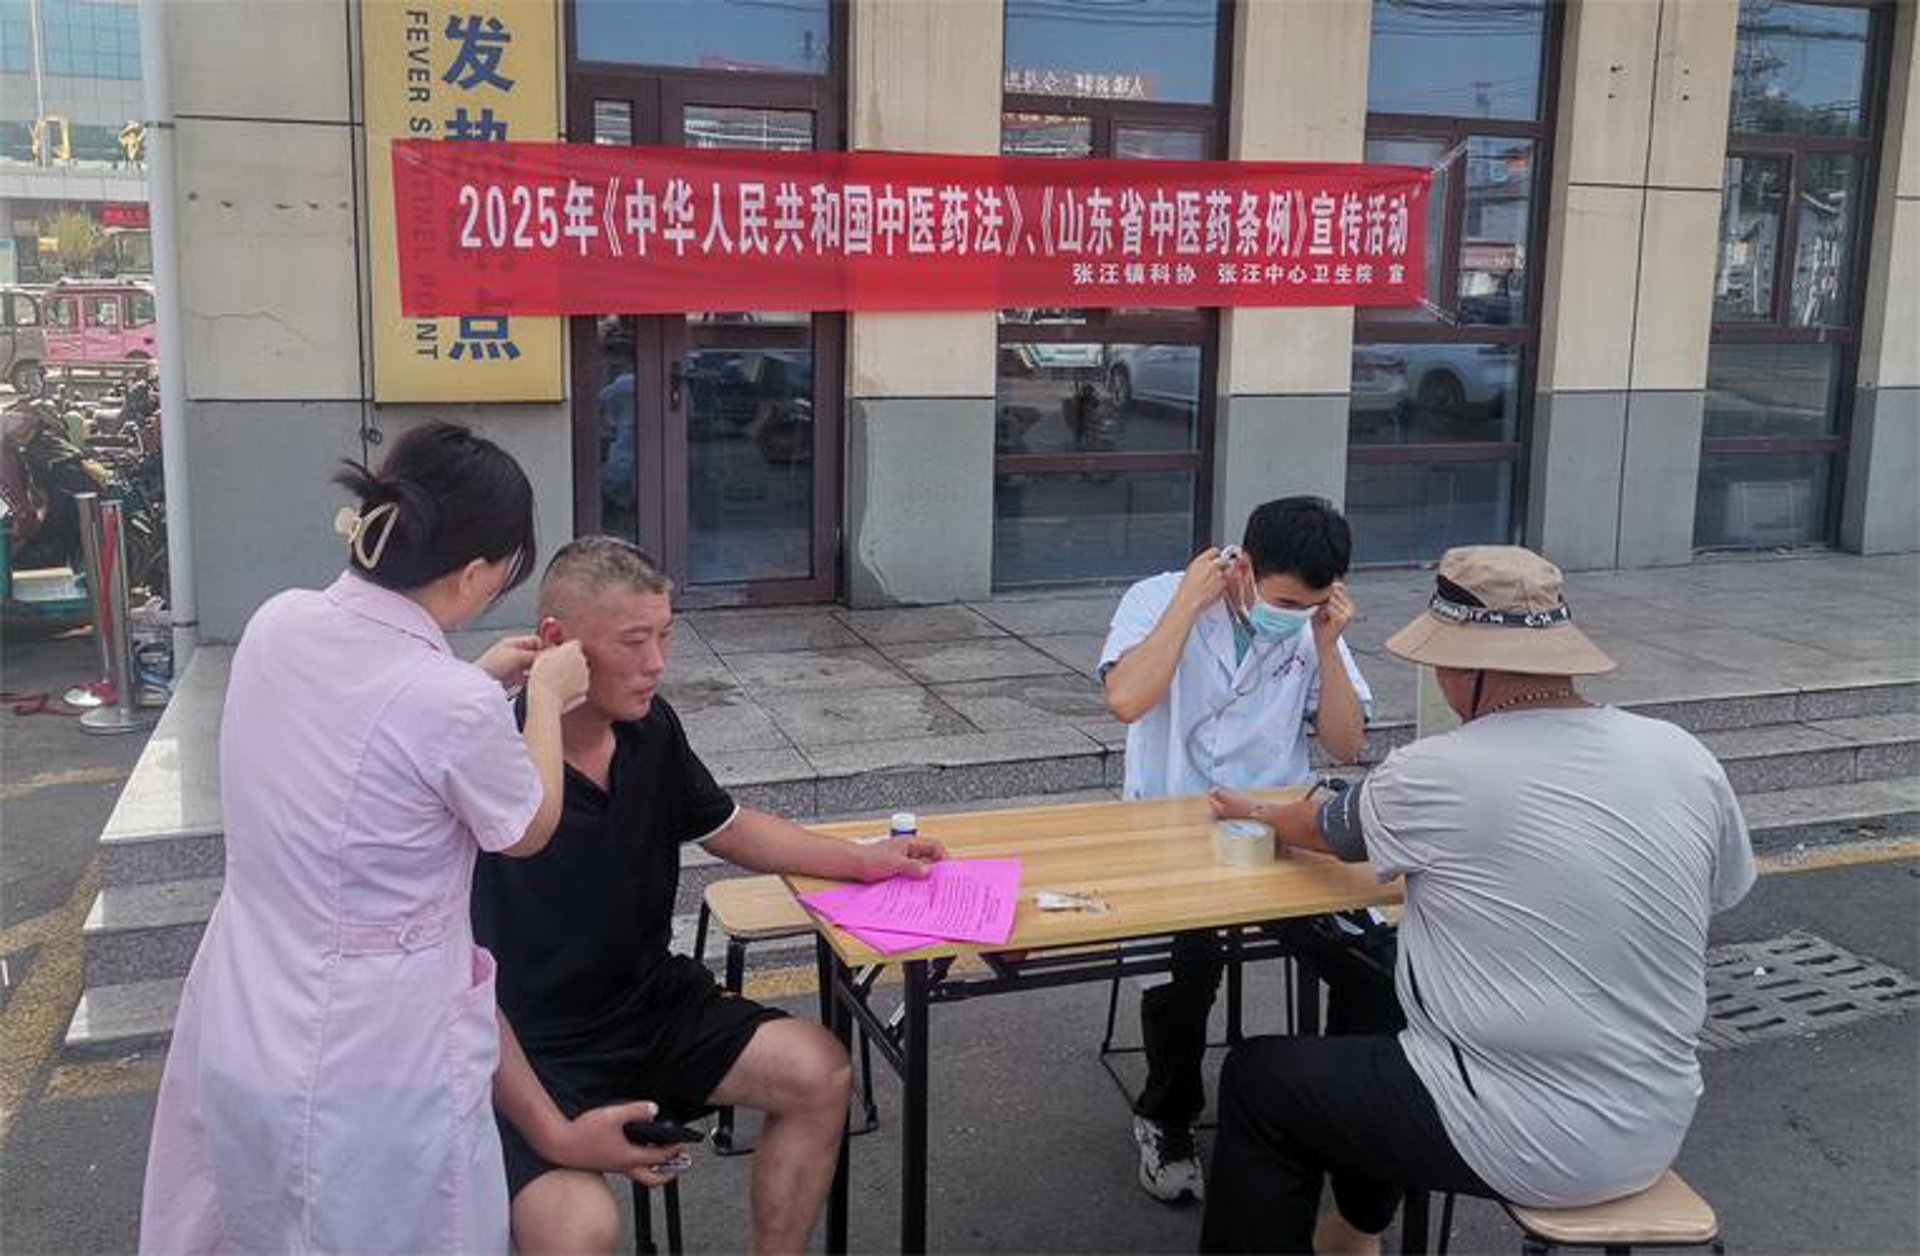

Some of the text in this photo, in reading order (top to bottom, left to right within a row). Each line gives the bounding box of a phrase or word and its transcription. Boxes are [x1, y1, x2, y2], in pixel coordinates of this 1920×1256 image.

[406, 10, 431, 102] FEVER
[458, 175, 1410, 258] 2025年《中华人民共和国中医药法》、《山东省中医药条例》宣传活动
[1072, 262, 1197, 286] 张汪镇科协
[1217, 263, 1374, 286] 张汪中心卫生院
